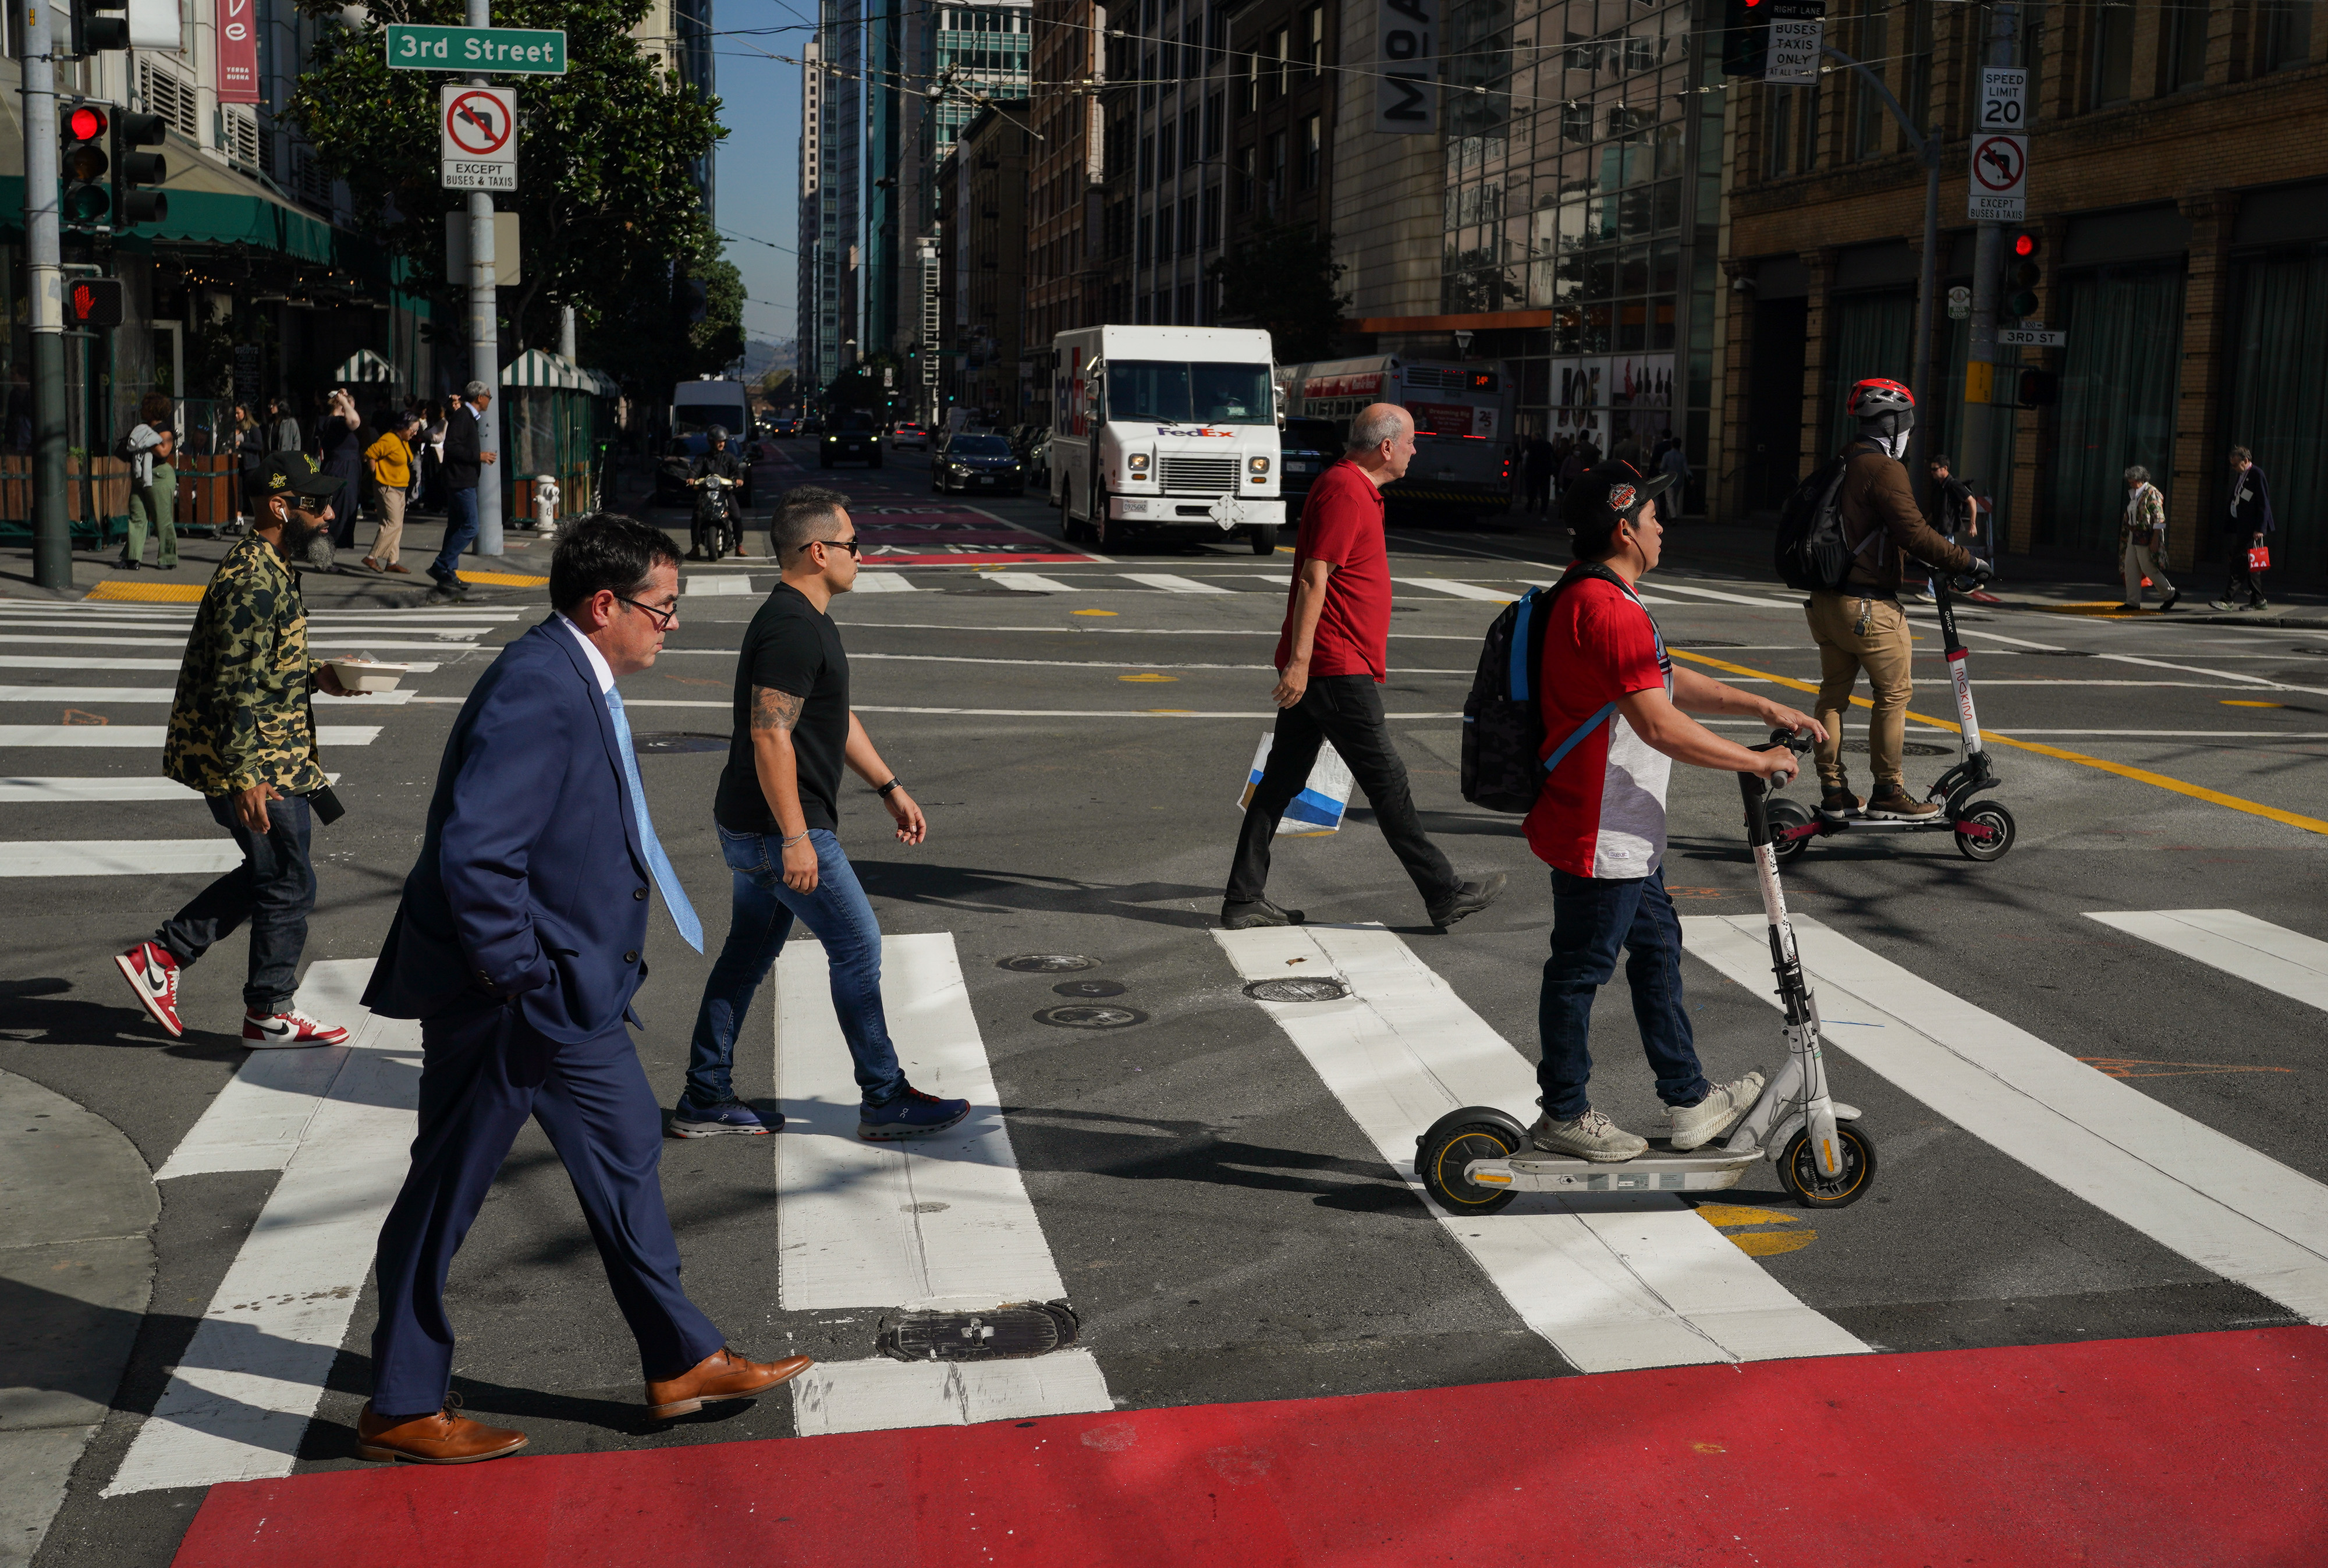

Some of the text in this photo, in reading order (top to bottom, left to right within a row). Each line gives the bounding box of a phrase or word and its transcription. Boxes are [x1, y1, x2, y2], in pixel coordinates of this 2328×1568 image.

[1773, 5, 1822, 15] RIGHT LANE
[1776, 24, 1816, 34] BUSES
[400, 35, 554, 63] 3rd Street
[1777, 39, 1813, 49] TAXIS
[1777, 54, 1809, 64] ONLY
[1986, 75, 2024, 84] SPEED
[1989, 87, 2019, 97] LIMIT
[1985, 100, 2021, 123] 20
[456, 164, 503, 175] EXCEPT
[446, 175, 474, 185] BUSES
[488, 176, 513, 187] TAXIS
[1981, 199, 2014, 208] EXCEPT
[1971, 208, 2022, 219] BUSES & TAXIS
[2007, 332, 2056, 342] 3RD ST
[1156, 427, 1237, 438] FedEx
[1610, 486, 1635, 510] LEGENDS
[1955, 668, 1972, 720] INOKIM
